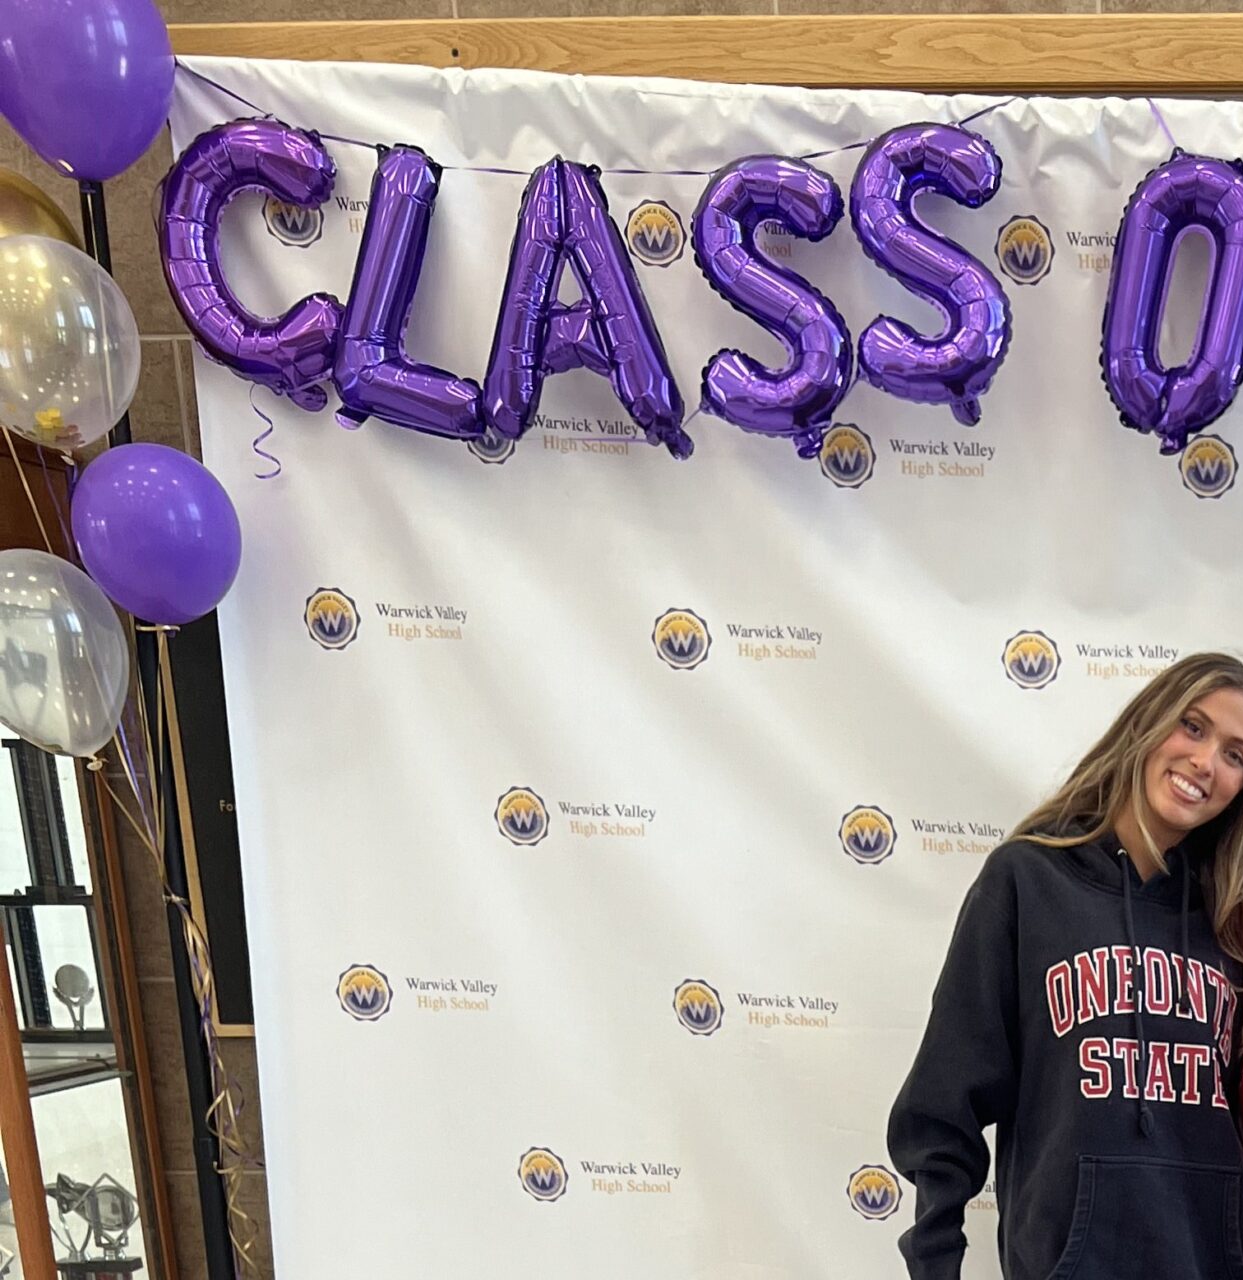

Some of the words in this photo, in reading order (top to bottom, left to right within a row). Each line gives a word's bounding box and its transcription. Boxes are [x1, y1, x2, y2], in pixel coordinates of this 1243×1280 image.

[160, 114, 1014, 460] CLASS
[890, 439, 948, 455] Warwick
[954, 442, 995, 460] Valley
[901, 460, 934, 477] High
[938, 462, 984, 477] School
[376, 603, 433, 619] Warwick
[436, 608, 468, 624] Valley
[388, 624, 422, 640] High
[426, 627, 462, 641] School
[727, 624, 783, 638] Warwick
[787, 627, 822, 644] Valley
[738, 644, 771, 659] High
[774, 646, 816, 659] School
[558, 802, 611, 816] Warwick
[615, 805, 656, 822] Valley
[570, 821, 598, 837] High
[602, 823, 645, 837] School
[406, 978, 455, 990] Warwick
[461, 980, 497, 996] Valley
[417, 996, 447, 1010] High
[450, 998, 489, 1010] School
[737, 993, 794, 1007] Warwick
[799, 996, 839, 1013] Valley
[748, 1013, 780, 1027] High
[785, 1015, 828, 1027] School
[581, 1161, 636, 1175] Warwick
[641, 1163, 681, 1179] Valley
[592, 1179, 622, 1194] High
[627, 1181, 671, 1193] School
